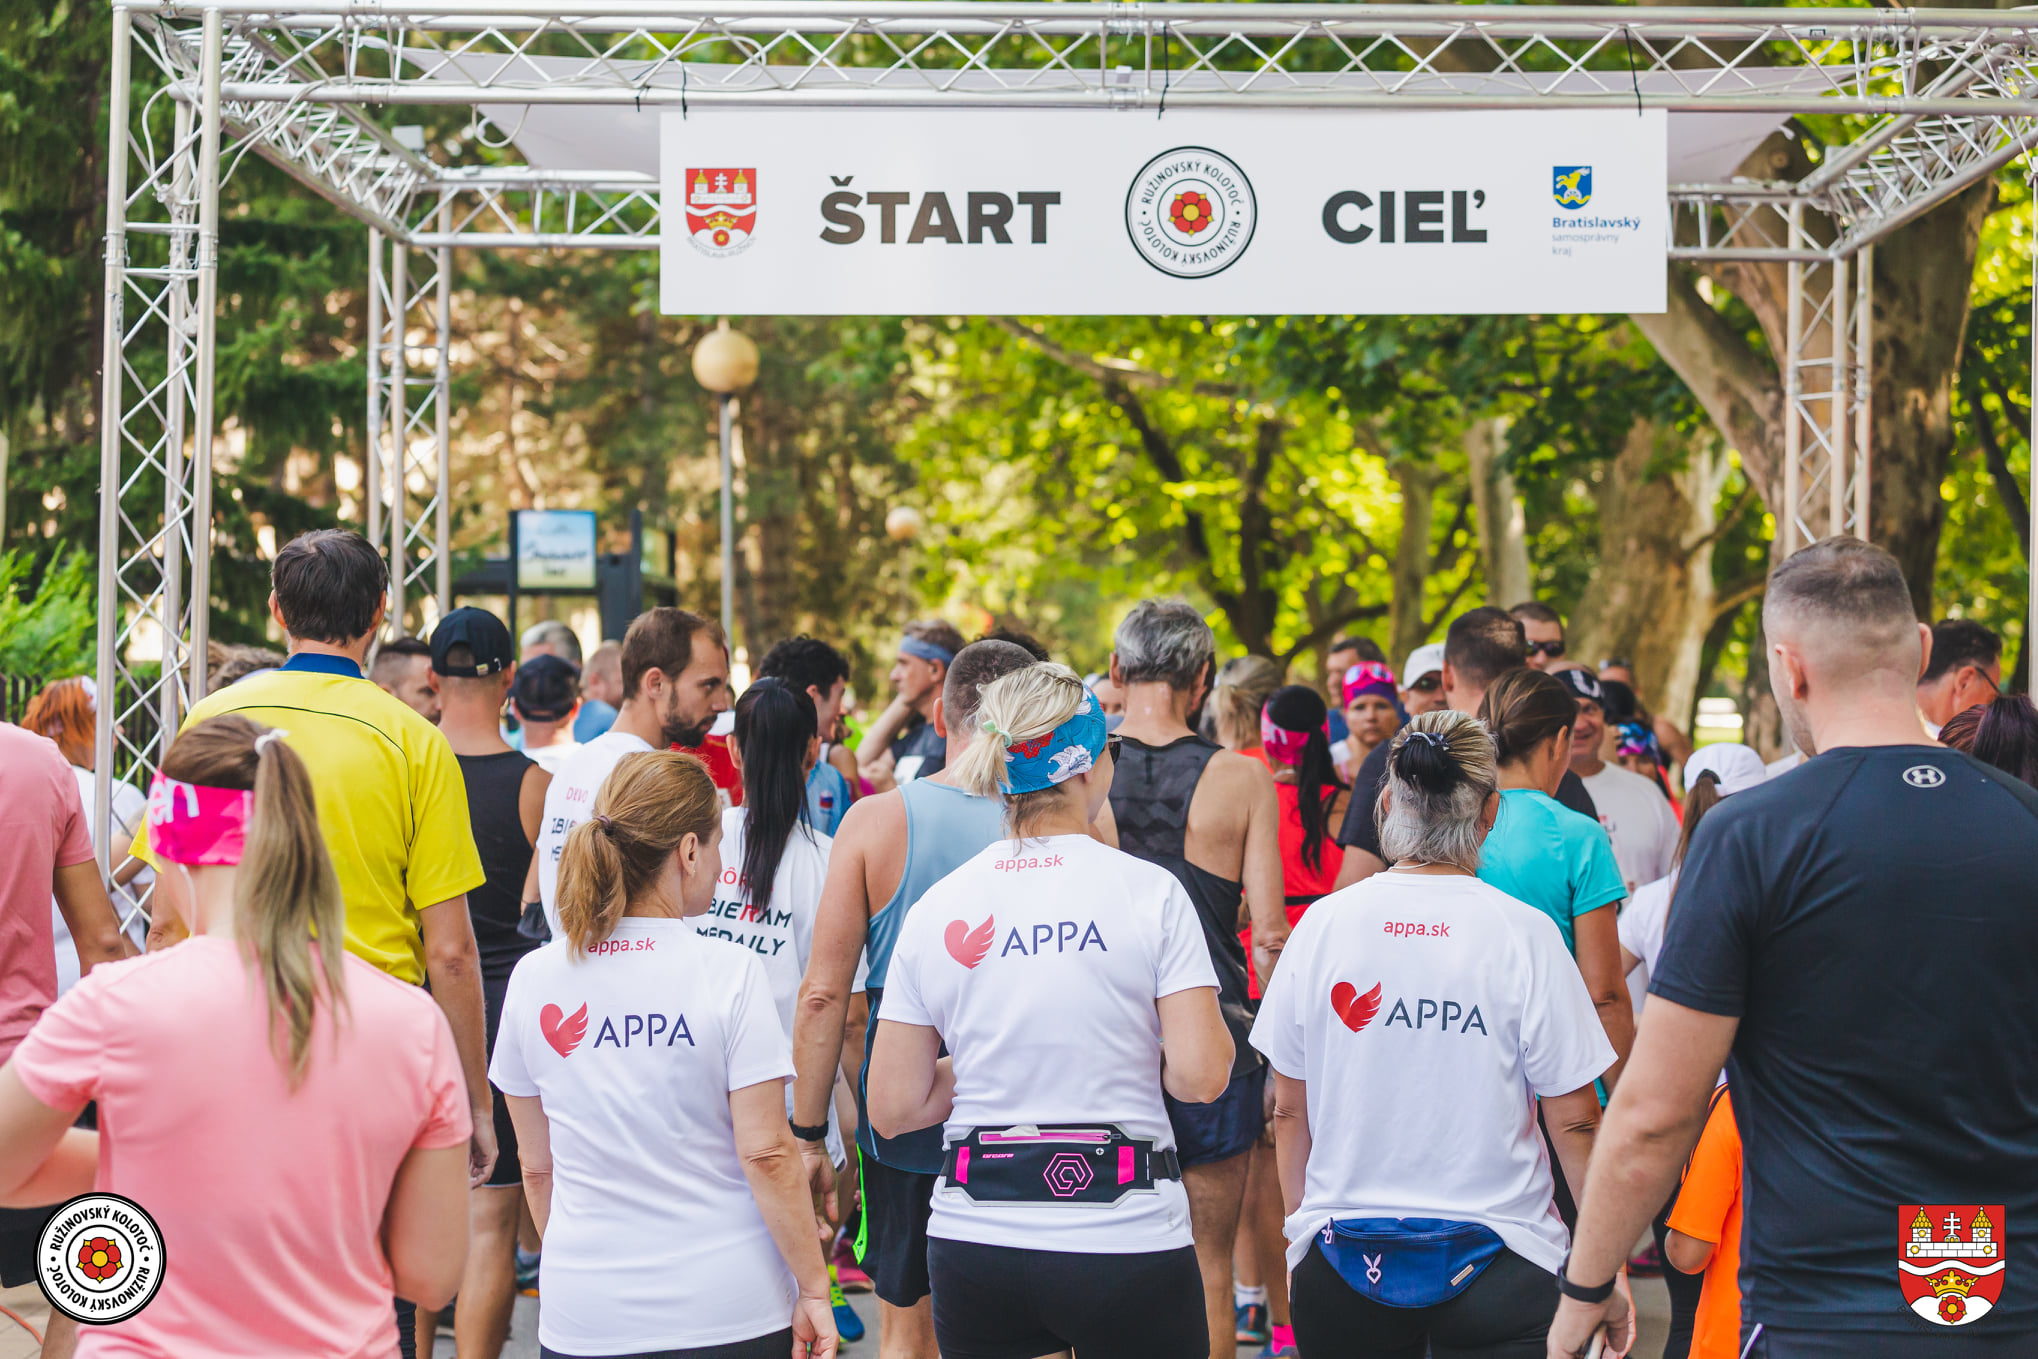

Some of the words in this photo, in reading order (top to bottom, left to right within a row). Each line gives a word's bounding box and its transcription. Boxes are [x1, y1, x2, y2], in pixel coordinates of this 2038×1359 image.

[1141, 159, 1201, 204] RUŽINOVSKÝ
[1203, 163, 1244, 206] KOLOTOČ
[819, 176, 1061, 245] ŠTART
[1322, 189, 1488, 244] CIEĽ
[1552, 216, 1641, 231] Bratislavský
[1138, 219, 1179, 262] KOLOTOČ
[1181, 221, 1241, 267] RUŽINOVSKÝ
[994, 854, 1065, 873] appa.sk
[587, 937, 656, 956] appa.sk
[1000, 920, 1108, 957] APPA
[1384, 921, 1450, 938] appa.sk
[593, 1012, 696, 1049] APPA
[1384, 997, 1488, 1036] APPA
